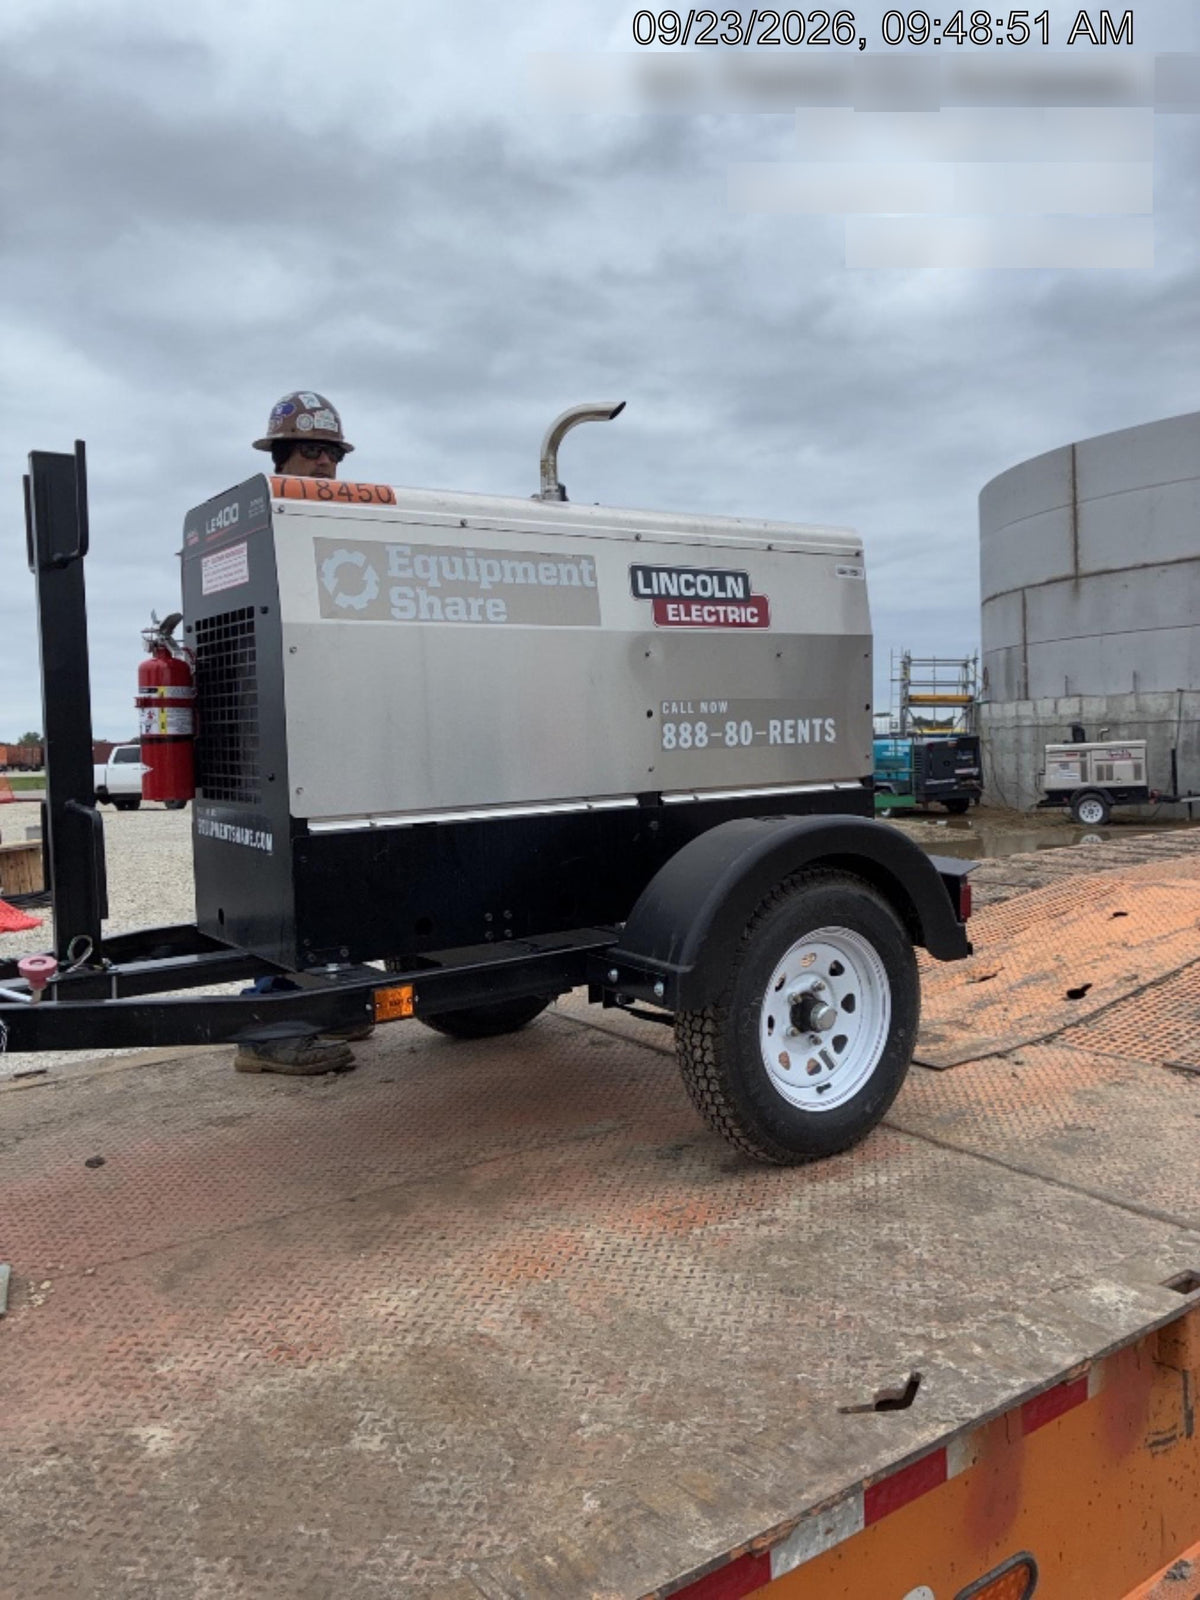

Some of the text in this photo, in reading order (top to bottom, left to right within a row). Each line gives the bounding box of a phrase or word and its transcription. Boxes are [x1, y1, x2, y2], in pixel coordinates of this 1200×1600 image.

[385, 544, 597, 590] Equipment
[637, 570, 744, 599] LINCOLN
[388, 584, 508, 623] Share
[666, 603, 759, 624] ELECTRIC
[662, 701, 728, 714] CALL NOW
[662, 718, 837, 750] 888-80-RENTS
